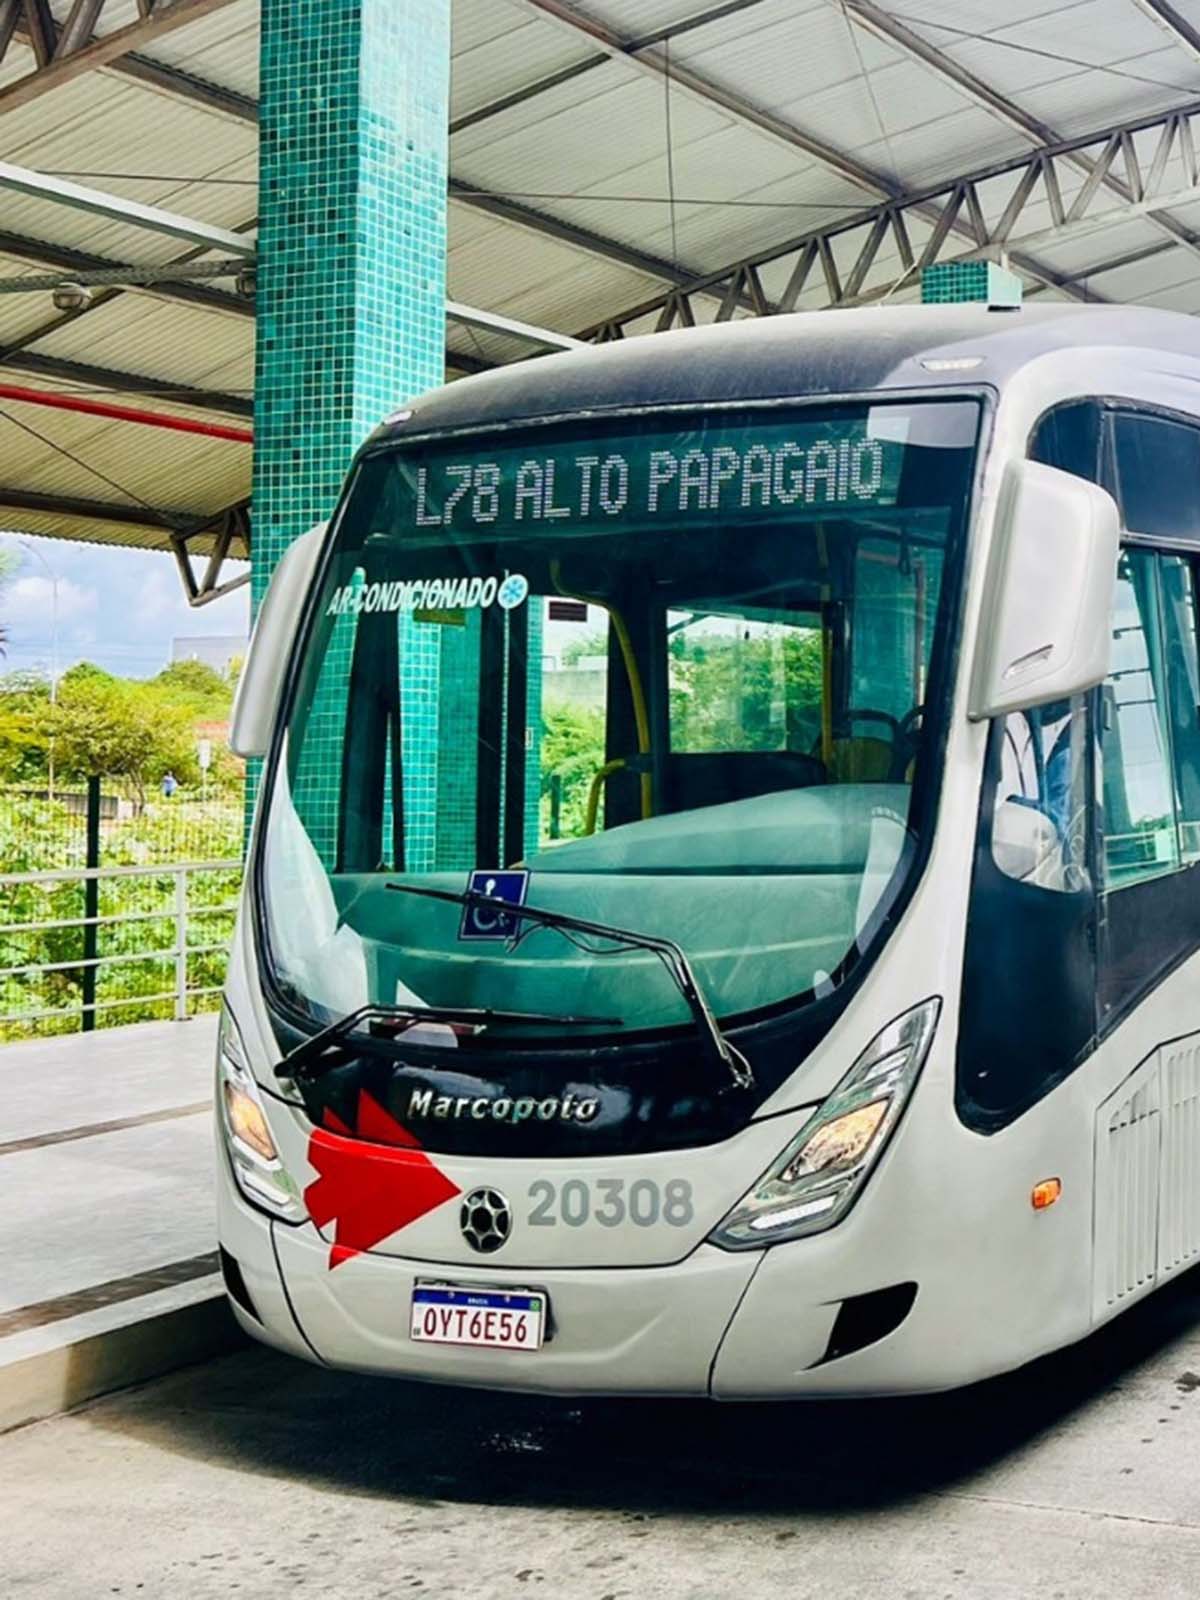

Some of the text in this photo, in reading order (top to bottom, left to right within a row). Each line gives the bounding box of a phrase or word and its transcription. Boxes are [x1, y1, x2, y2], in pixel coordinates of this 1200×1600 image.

[416, 437, 884, 526] L78 ALTO PAPAGAIO
[408, 1088, 598, 1124] Marcopolo
[527, 1178, 694, 1227] 20308
